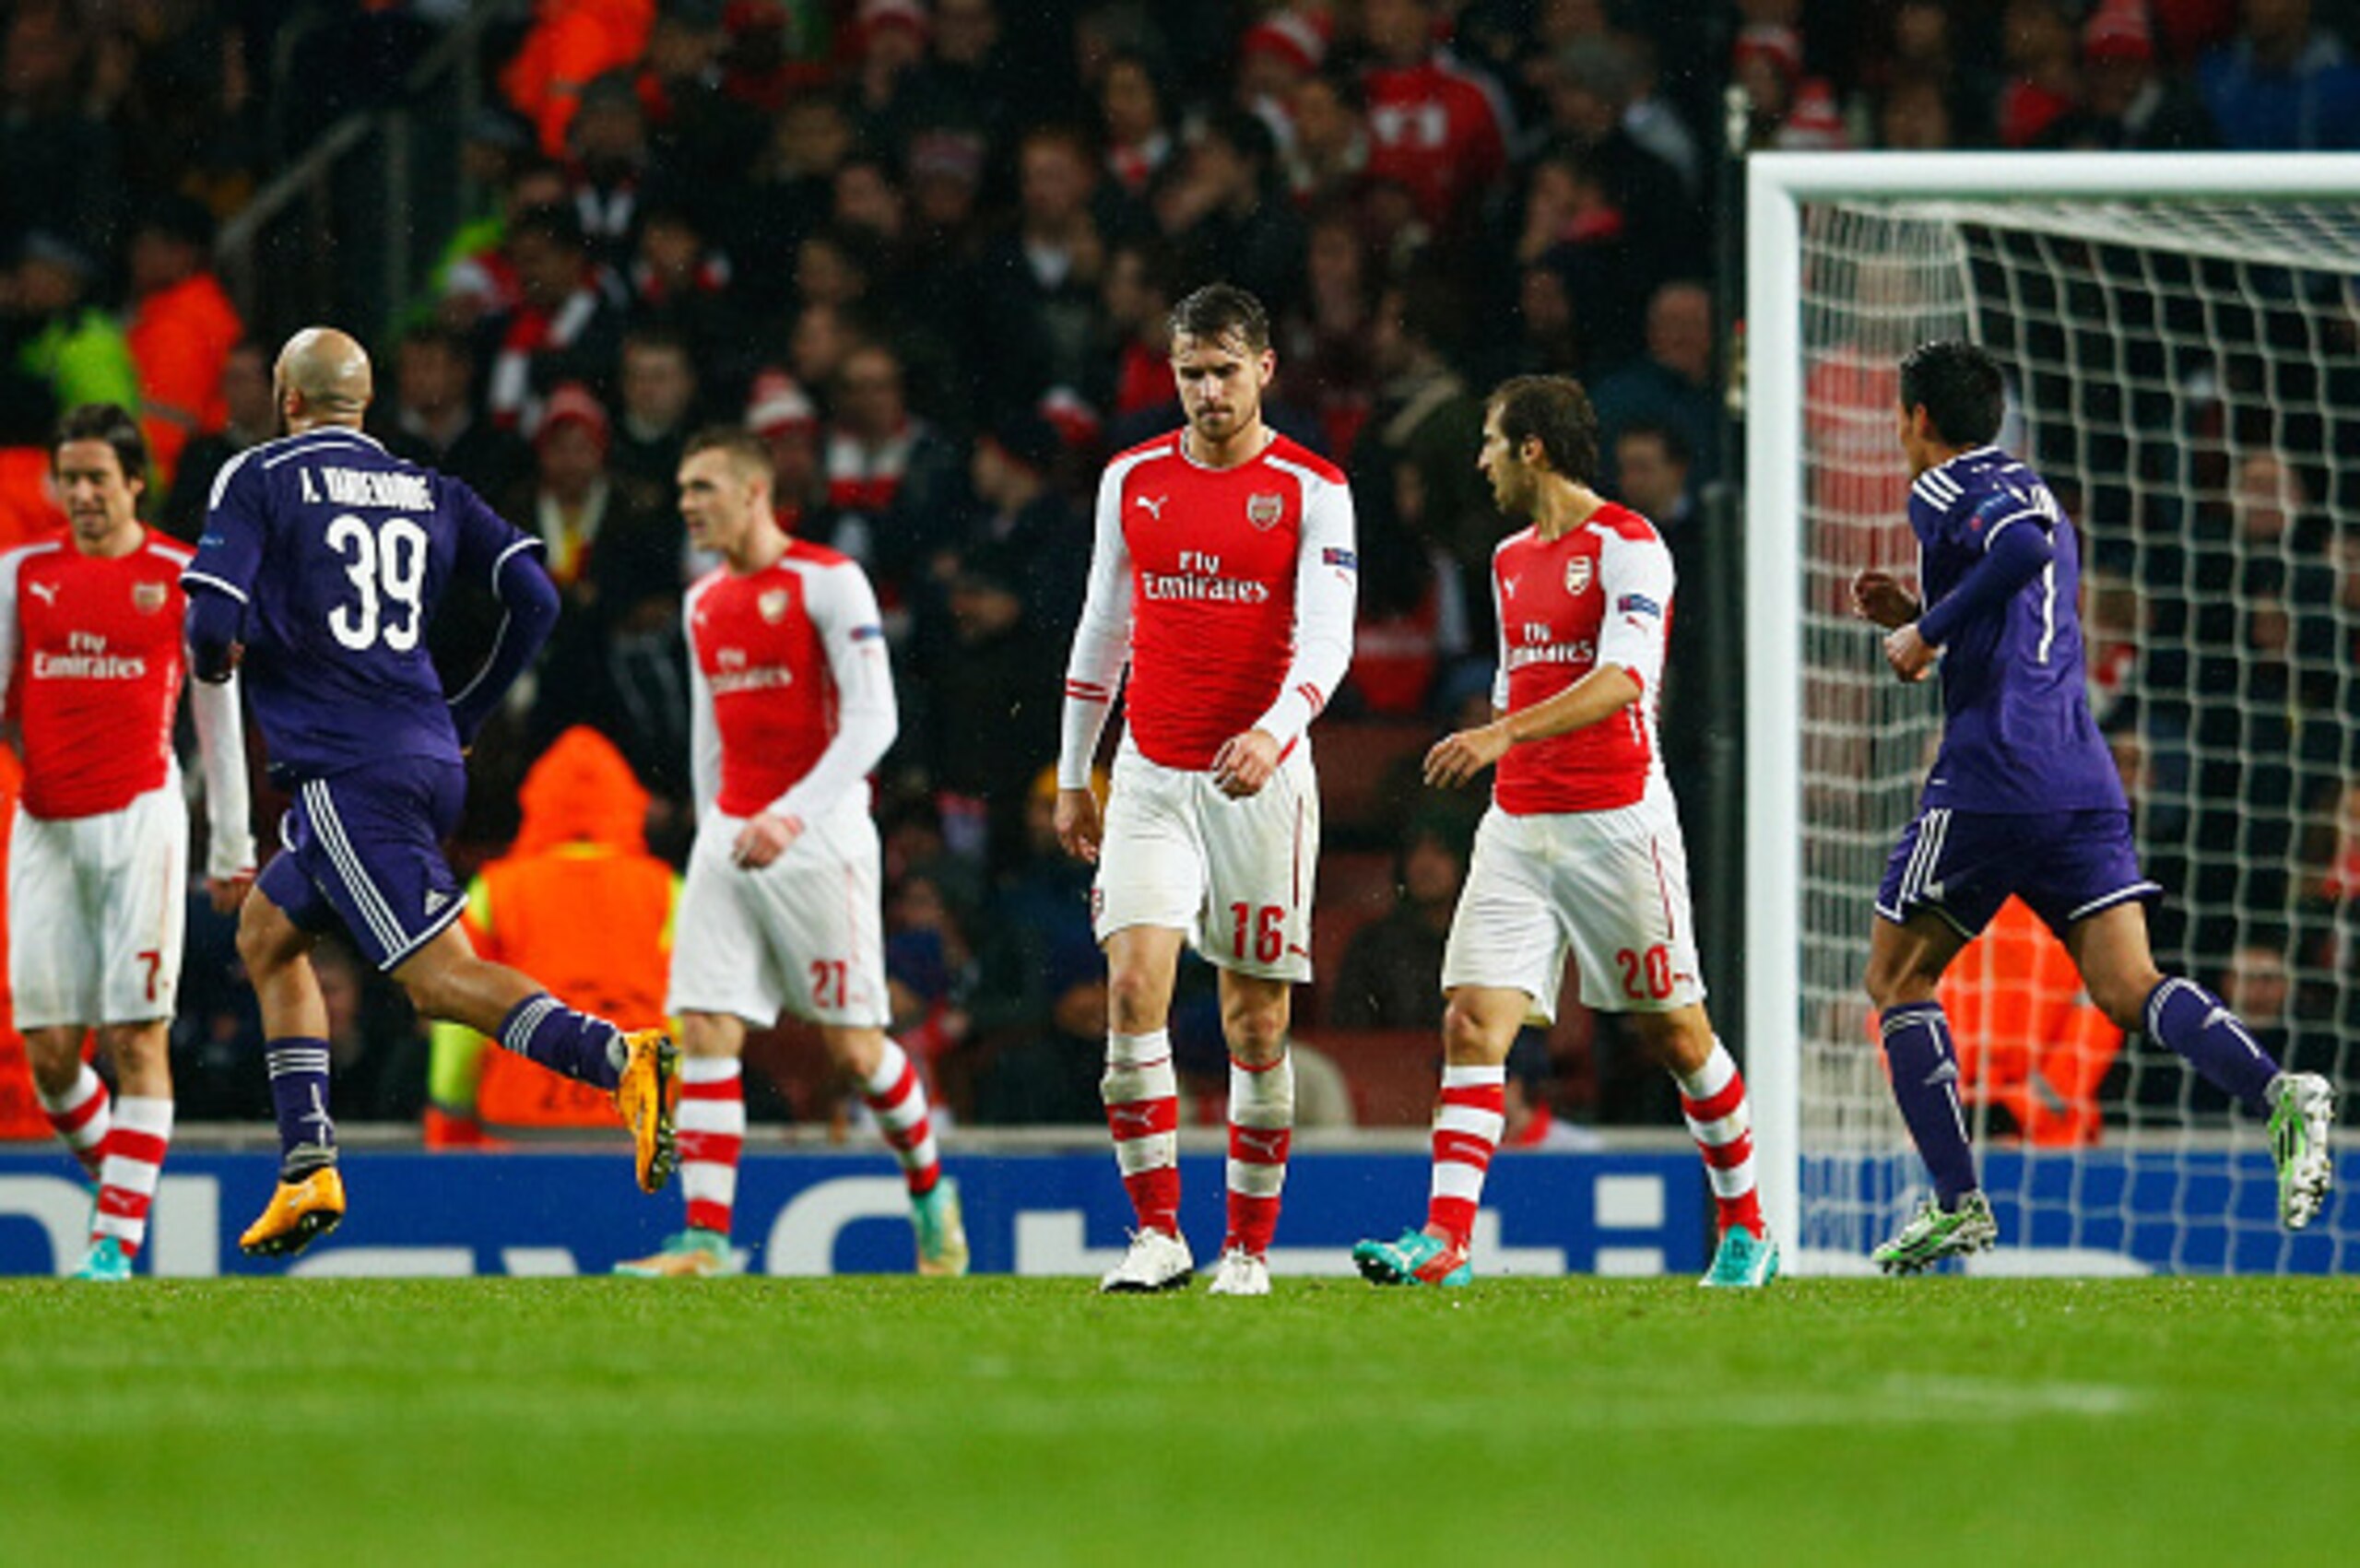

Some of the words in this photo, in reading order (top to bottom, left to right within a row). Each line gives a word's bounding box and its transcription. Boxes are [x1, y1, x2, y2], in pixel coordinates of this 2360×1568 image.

[326, 515, 427, 652] 39
[1178, 551, 1219, 574] Fly
[1142, 573, 1268, 603] Emirates
[33, 651, 145, 679] Emirates
[69, 631, 106, 655] Fly
[1230, 902, 1286, 964] 16
[136, 950, 161, 1003] 7
[809, 960, 846, 1009] 21
[1616, 944, 1673, 1000] 20
